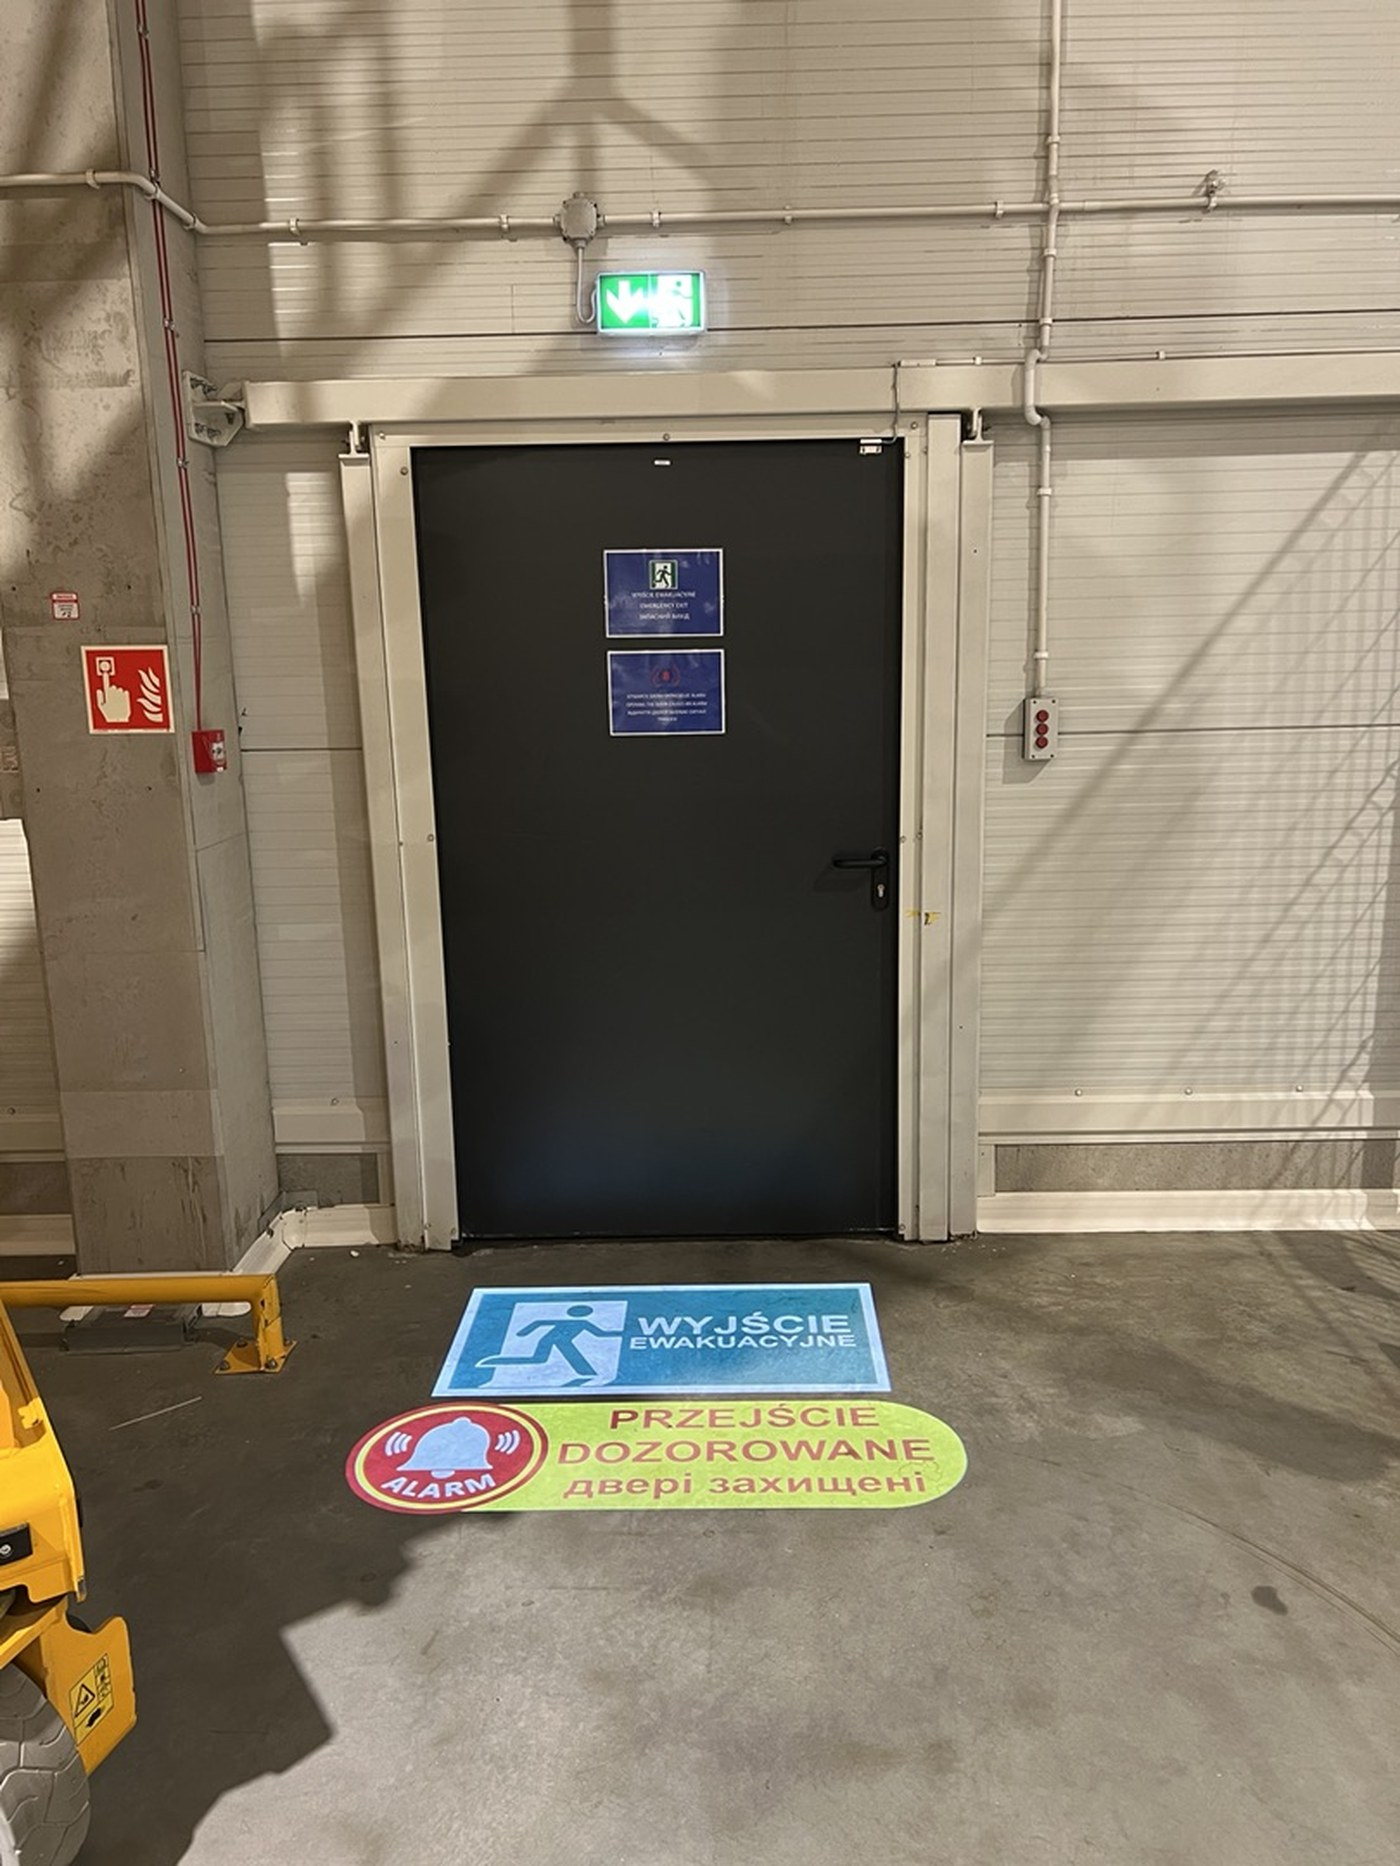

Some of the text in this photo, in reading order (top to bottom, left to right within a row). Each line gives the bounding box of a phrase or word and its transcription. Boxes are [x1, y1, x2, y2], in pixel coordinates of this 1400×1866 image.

[637, 1311, 852, 1336] WYJŚCIE
[629, 1334, 857, 1349] EWAKUACYJNE
[609, 1402, 881, 1430] PRZEJŚCIE
[556, 1438, 935, 1465] DOZOROWANE
[380, 1472, 497, 1499] ALARM
[562, 1470, 927, 1499] двері захищені
